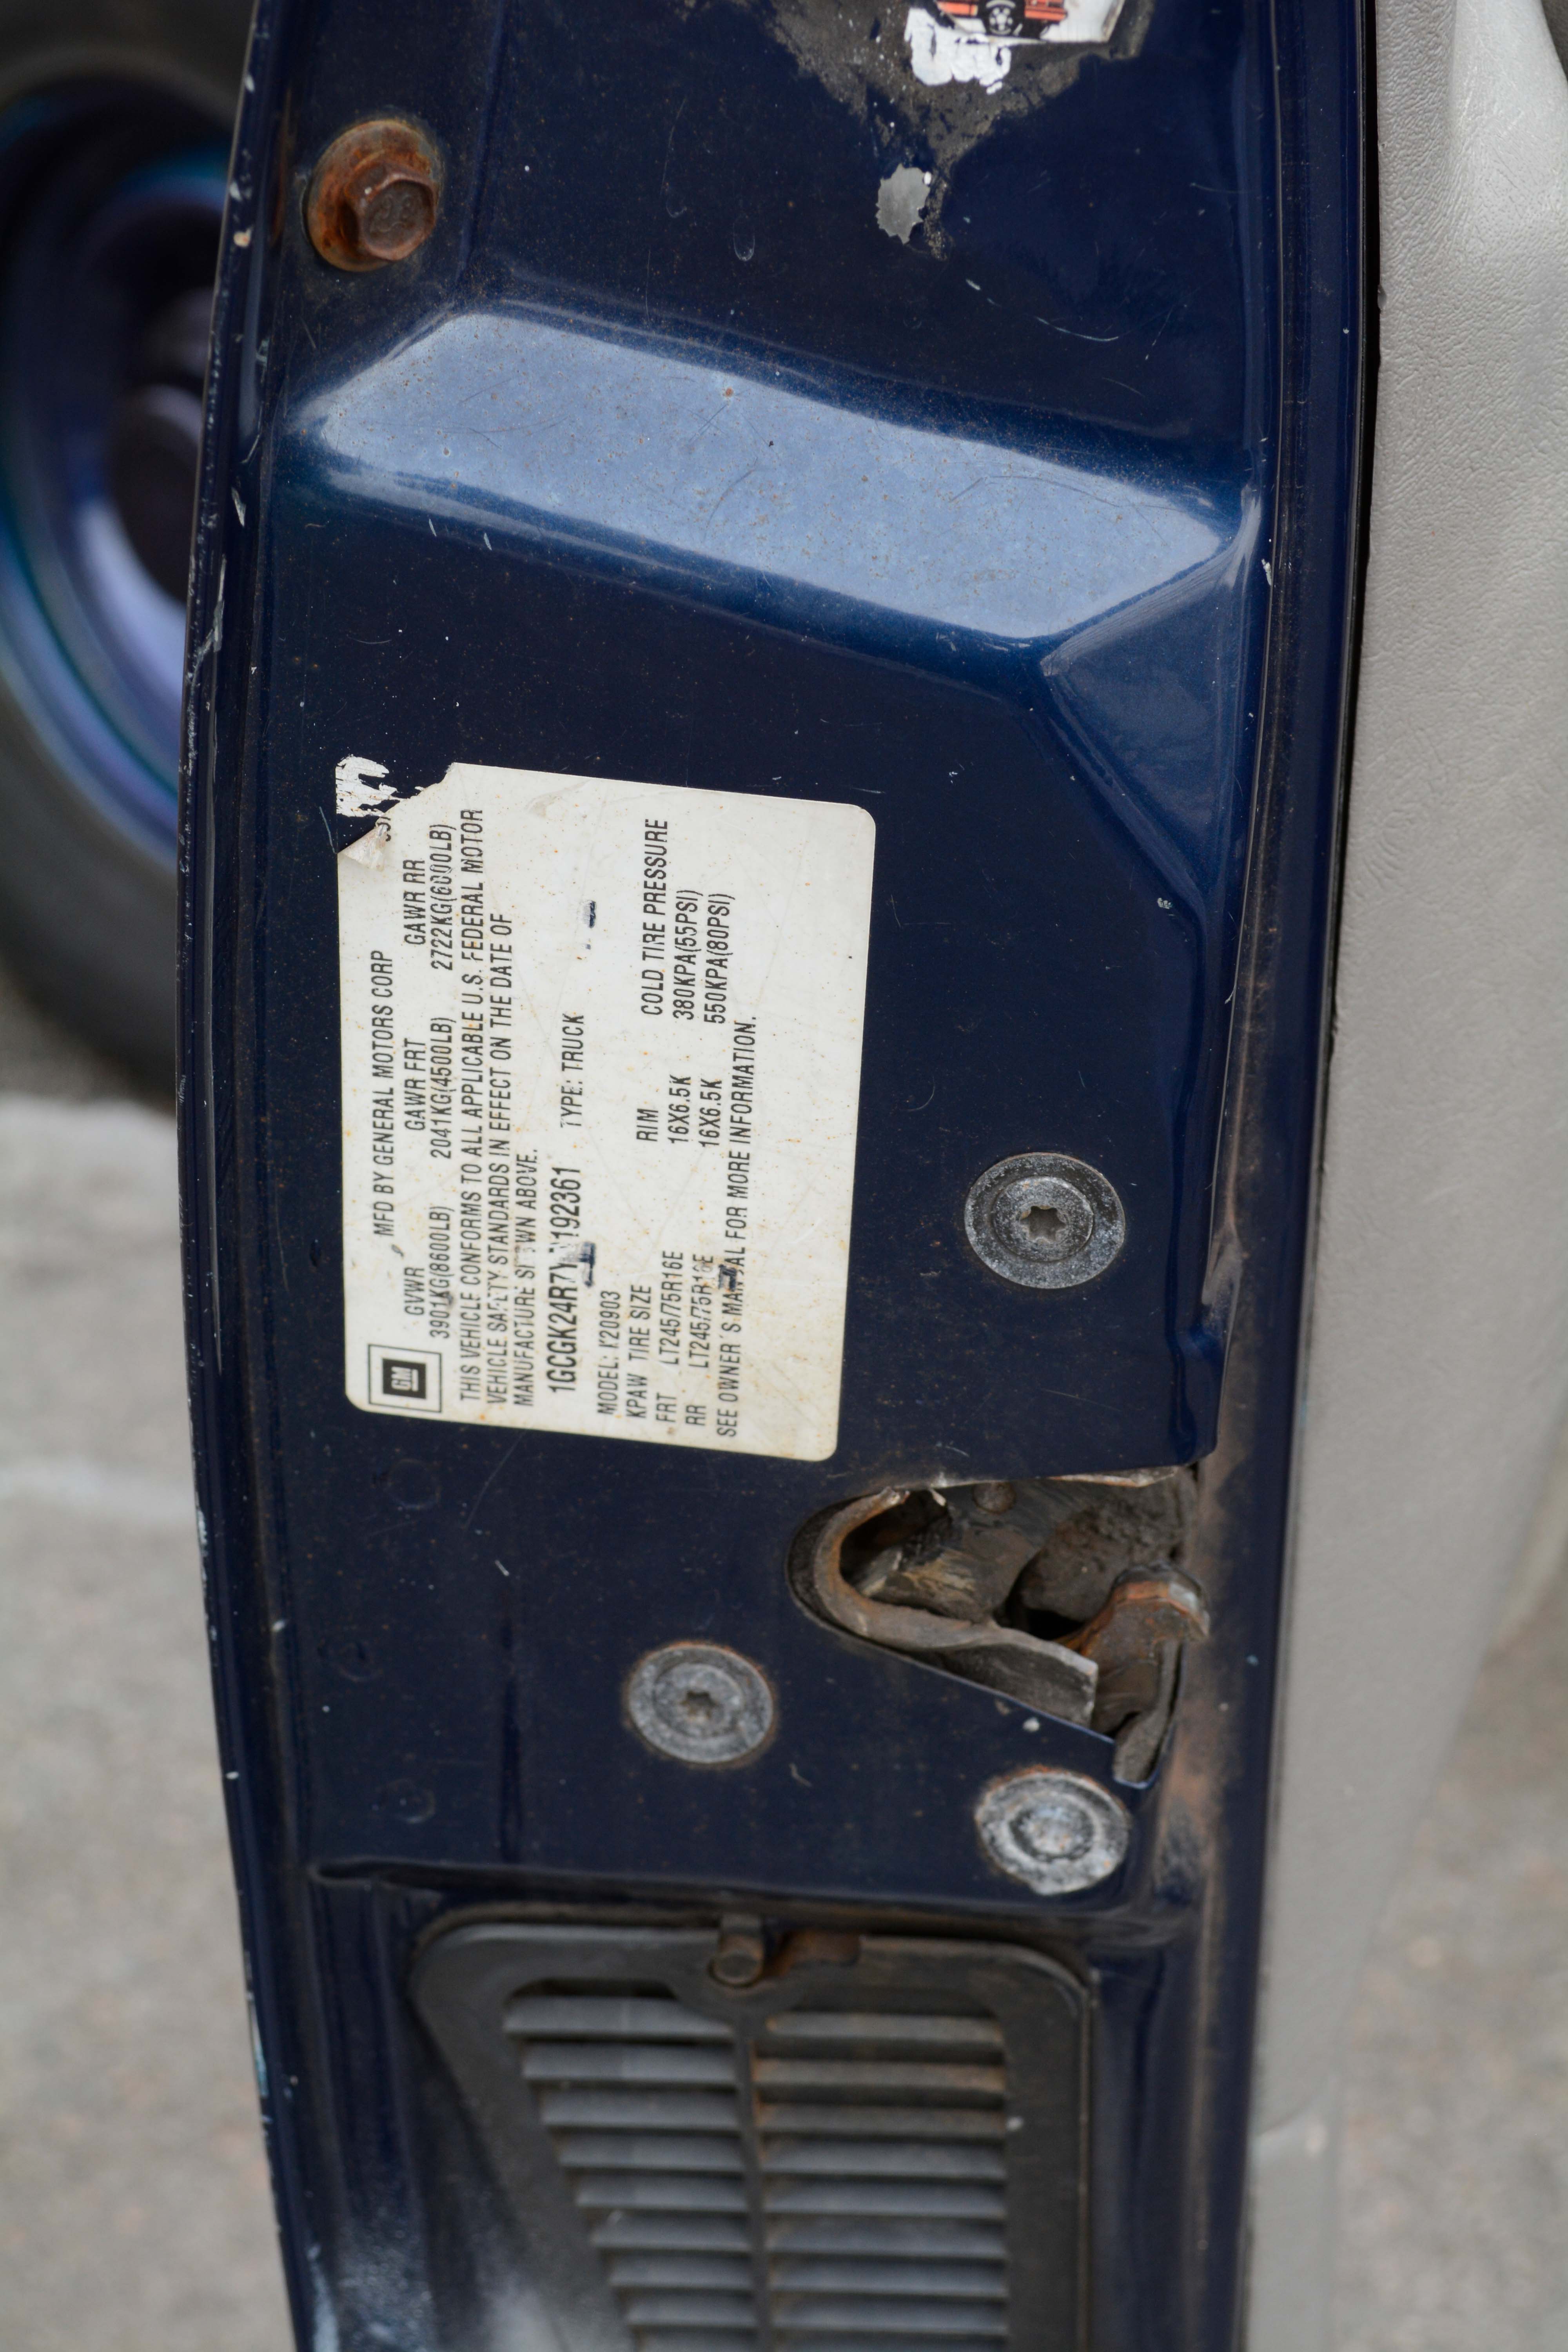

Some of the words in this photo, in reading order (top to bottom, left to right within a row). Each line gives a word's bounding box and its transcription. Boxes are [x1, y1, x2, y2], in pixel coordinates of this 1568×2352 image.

[460, 809, 483, 874] MOTOR
[403, 860, 425, 884] RR
[643, 818, 668, 916] PRESSURE
[403, 891, 426, 945] GAWR
[429, 824, 457, 971] 2722KG(6000LB)
[461, 882, 484, 961] FEDERAL
[490, 913, 512, 936] OF
[642, 922, 665, 961] TIRE
[370, 950, 393, 998] CORP
[490, 943, 512, 988] DATE
[672, 889, 704, 1020] 380KPA(55PSI)
[704, 893, 735, 1024] 550KPA(80PSI)
[461, 970, 483, 1004] U.S.
[490, 995, 512, 1028] THE
[641, 969, 664, 1015] COLD
[371, 1004, 394, 1078] MOTORS
[403, 1038, 426, 1071] FRT
[461, 1012, 483, 1119] APPLICABLE
[490, 1037, 511, 1060] ON
[561, 1013, 584, 1072] TRUCK
[404, 1078, 425, 1131] GAWR
[430, 1017, 456, 1159] 2041KG(4500LB)
[489, 1067, 511, 1131] EFFECT
[560, 1080, 583, 1128] TYPE:
[729, 1017, 756, 1144] INFORMATION.
[372, 1087, 394, 1165] GENERAL
[636, 1108, 659, 1142] RIM
[668, 1074, 691, 1144] 16X6.5K
[698, 1078, 722, 1147] 16X6.5K
[461, 1126, 482, 1157] ALL
[489, 1139, 510, 1156] IN
[373, 1171, 394, 1194] BY
[461, 1163, 482, 1184] TO
[516, 1149, 537, 1210] ABOVE.
[727, 1151, 750, 1199] MORE
[373, 1201, 394, 1236] MFD
[461, 1191, 481, 1285] CONFORMS
[488, 1163, 509, 1265] STANDARDS
[725, 1207, 747, 1240] FOR
[404, 1267, 424, 1315] GVWR
[429, 1206, 453, 1338] 3901KG(8600LB)
[547, 1167, 581, 1393] 1GCGK24R7Y192361
[460, 1293, 481, 1358] VEHICLE
[599, 1291, 621, 1348] K20903
[630, 1285, 651, 1320] SIZE
[659, 1251, 683, 1365] LT245/75R16E
[514, 1287, 535, 1406] MANUFACTURE
[628, 1327, 650, 1360] TIRE
[390, 1367, 414, 1391] GM
[460, 1365, 480, 1400] THIS
[487, 1340, 507, 1403] VEHICLE
[597, 1356, 618, 1414] MODEL:
[626, 1374, 647, 1418] KPAW
[656, 1393, 676, 1422] FRT
[685, 1405, 706, 1426] RR
[717, 1410, 737, 1437] SEE
